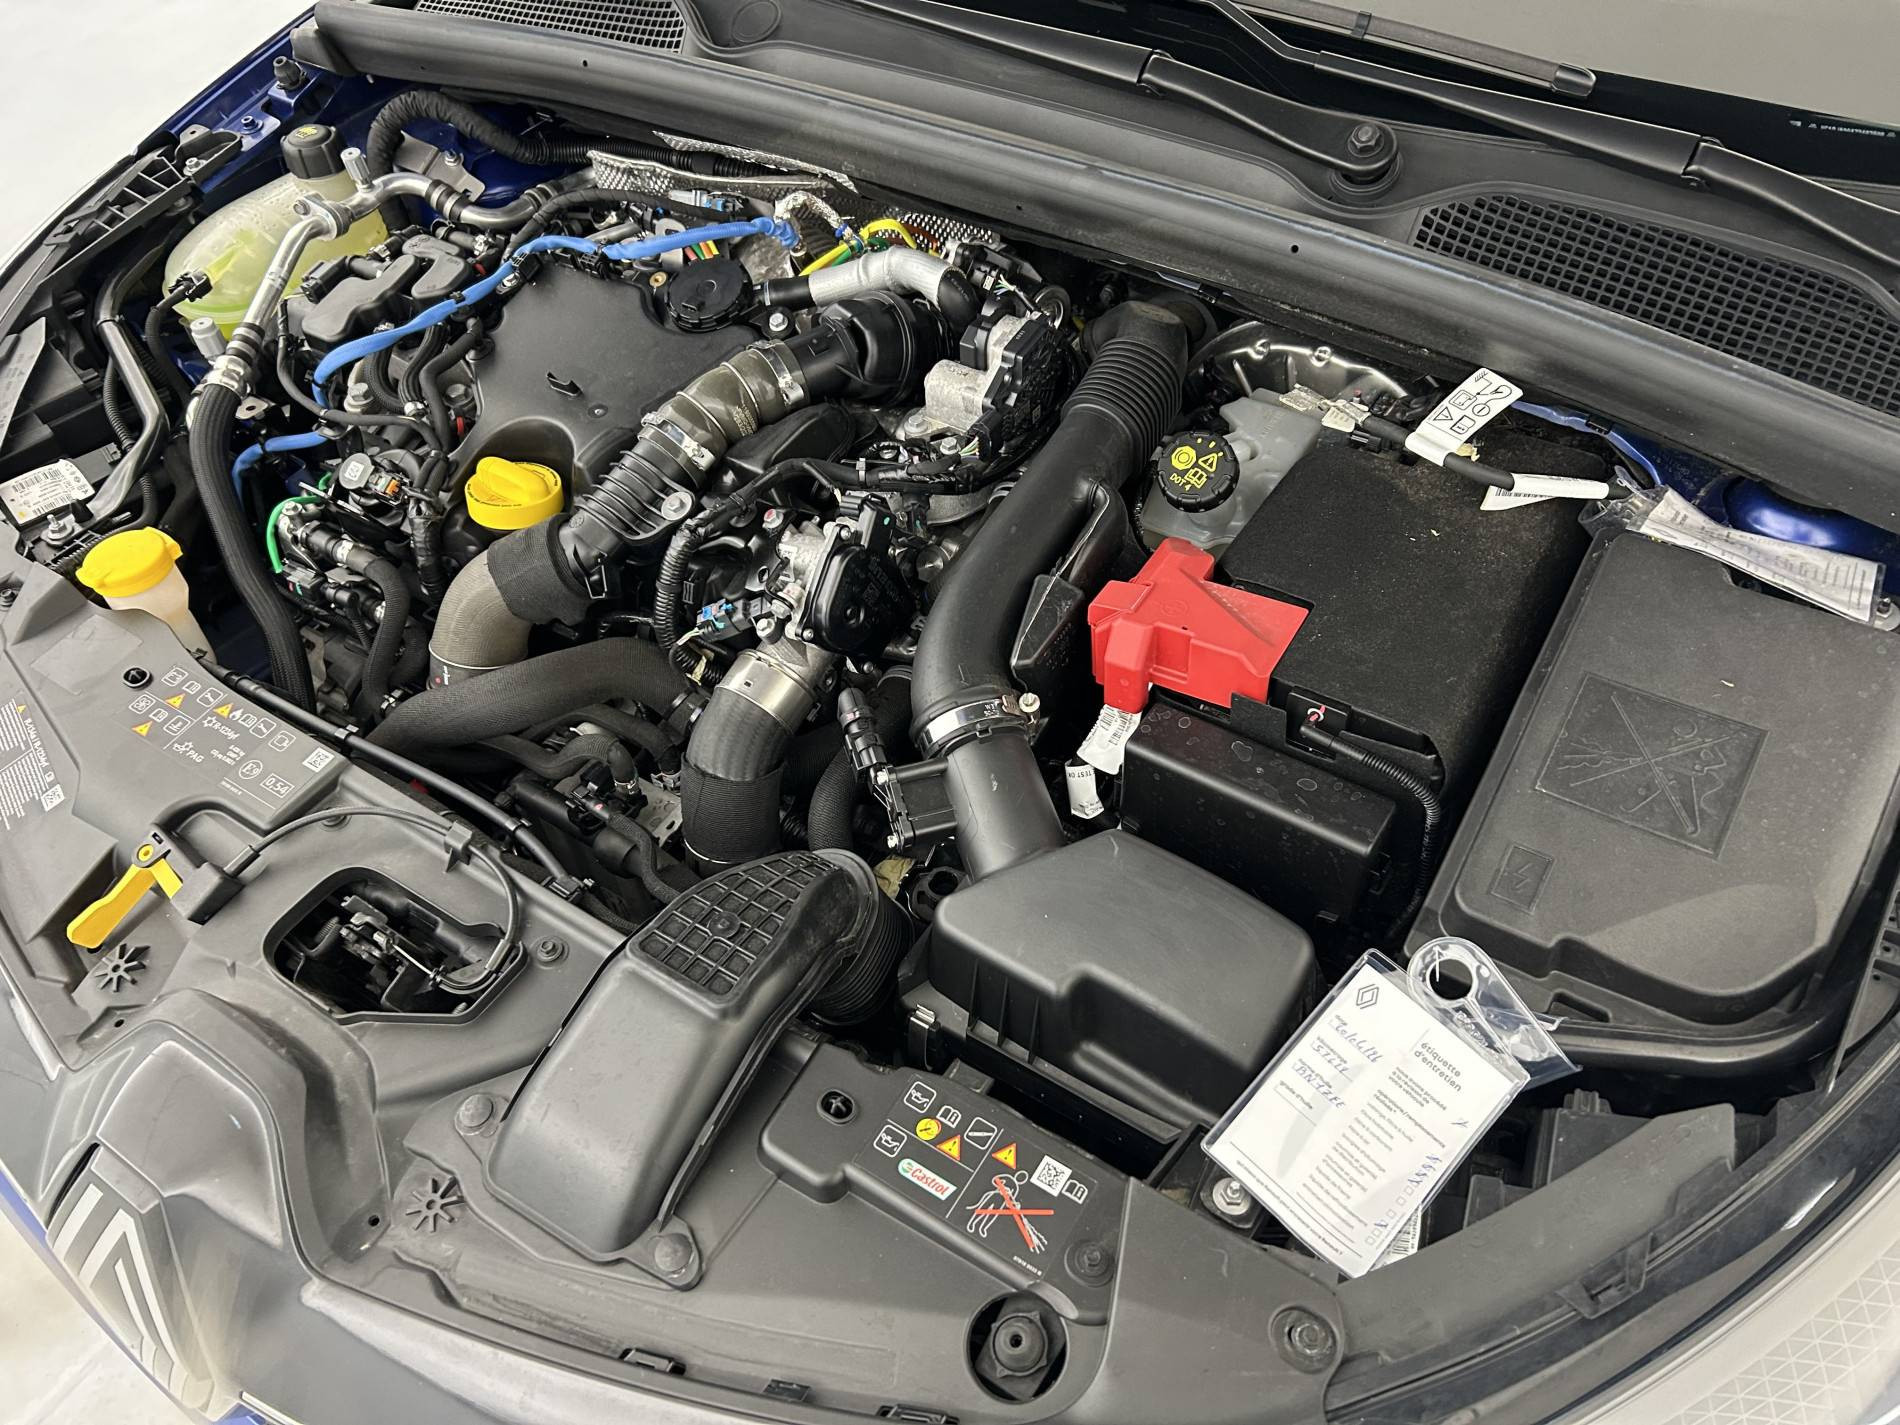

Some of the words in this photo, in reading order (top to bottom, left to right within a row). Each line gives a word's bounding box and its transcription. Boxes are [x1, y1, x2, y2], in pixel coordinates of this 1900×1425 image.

[1169, 473, 1187, 487] DOT
[210, 719, 240, 743] R-1234yf
[185, 748, 204, 764] PAG
[264, 775, 288, 796] 0,54
[1412, 1047, 1463, 1092] d'entretien
[1418, 1039, 1463, 1079] étiquette
[911, 1165, 951, 1197] Castrol
